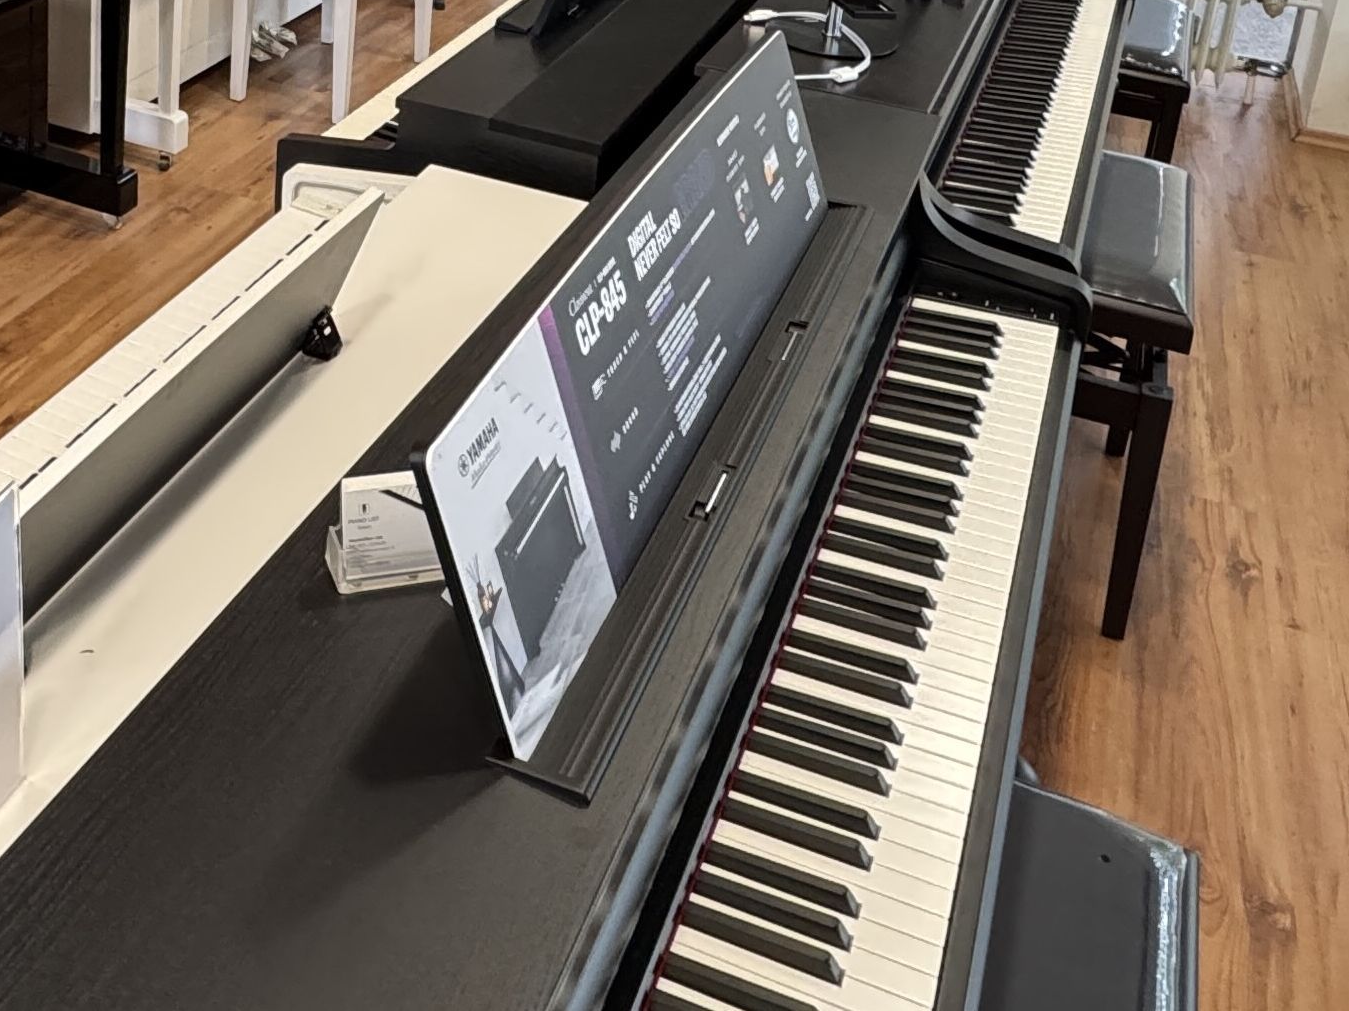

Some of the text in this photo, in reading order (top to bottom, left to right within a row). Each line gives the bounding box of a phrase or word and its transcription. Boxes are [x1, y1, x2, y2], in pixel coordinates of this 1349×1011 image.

[627, 210, 657, 258] DIGITAL
[634, 208, 681, 281] NEVER FELT SO
[575, 269, 627, 356] CLP-845
[466, 417, 499, 465] YAMAHA
